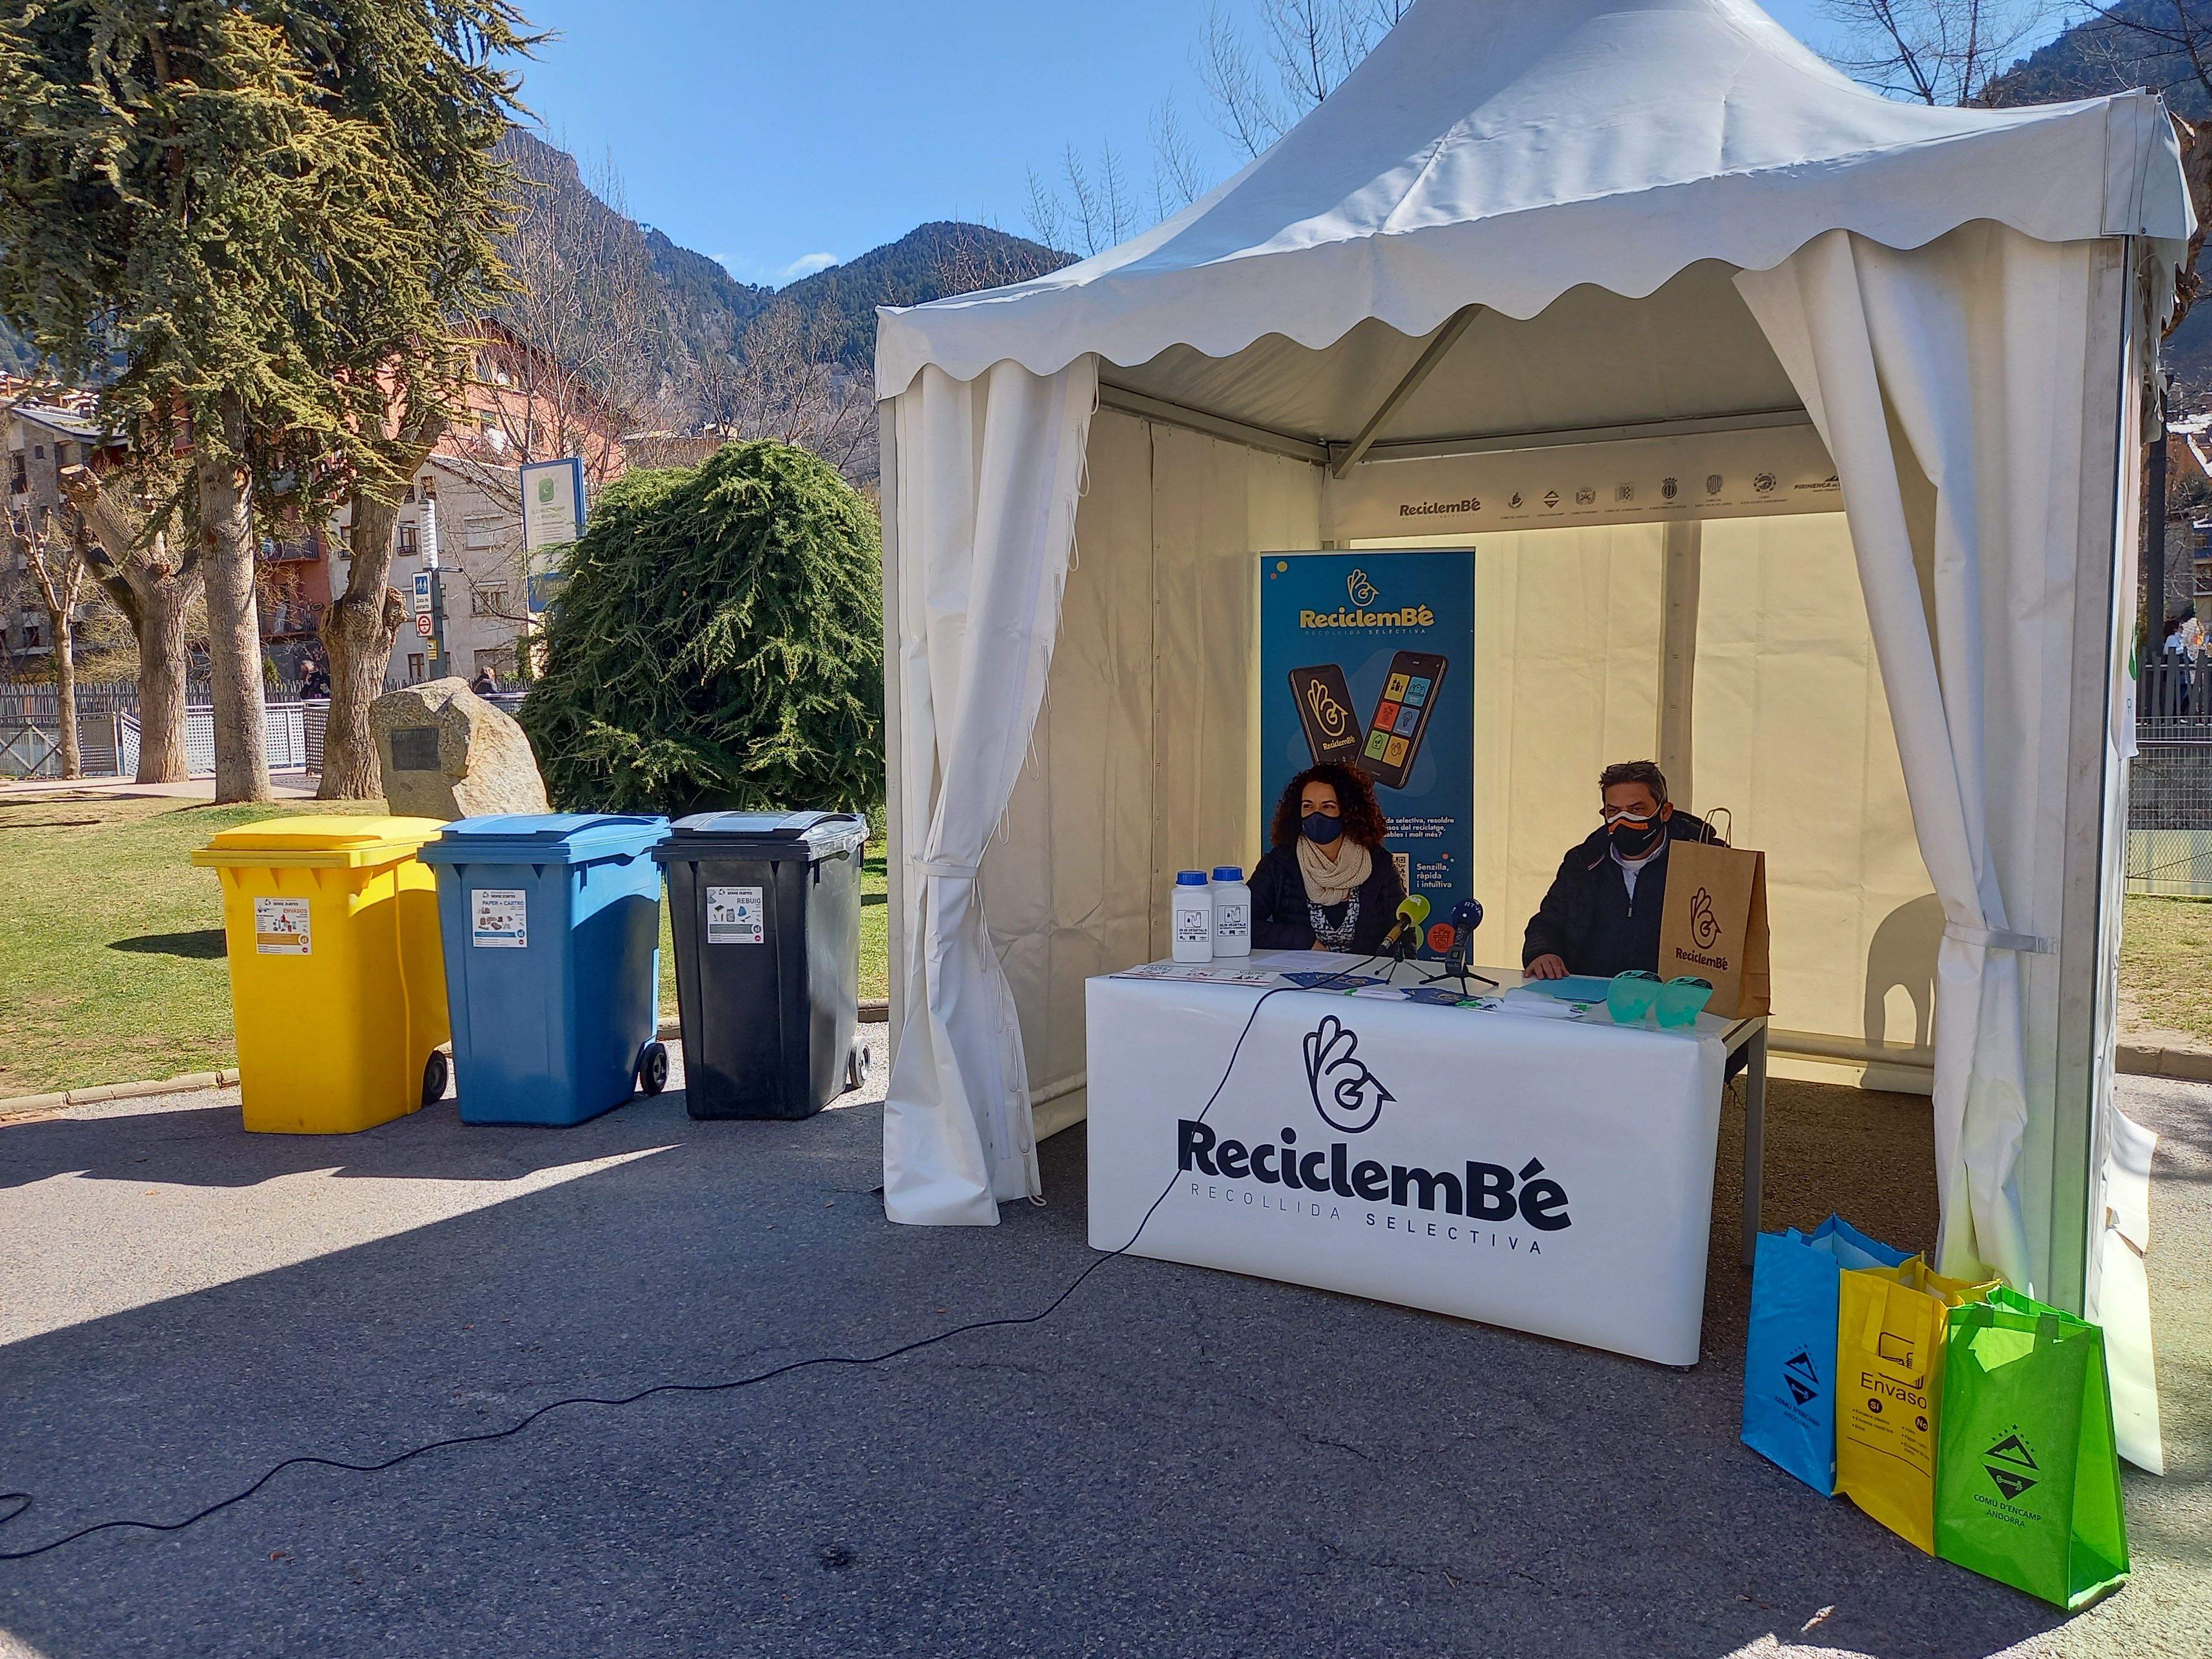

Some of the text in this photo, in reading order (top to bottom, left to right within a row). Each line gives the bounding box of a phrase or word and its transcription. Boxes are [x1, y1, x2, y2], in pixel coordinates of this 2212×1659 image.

[1400, 498, 1481, 516] ReciclemBé
[1300, 604, 1435, 628] ReciclemBé
[1322, 734, 1356, 752] ReciclemBé
[1412, 823, 1446, 832] reciclatge,
[1416, 863, 1449, 872] Senzilla,
[1416, 872, 1442, 881] ràpida
[1676, 947, 1728, 971] ReciclemBé
[1178, 1119, 1572, 1231] ReciclemBé
[1191, 1183, 1541, 1254] RECOLLIDA SELECTIVA
[1870, 1400, 1880, 1411] Sí
[1916, 1418, 1928, 1430] No
[1973, 1494, 2042, 1522] COMÚ D'ENCAMP
[1986, 1509, 2026, 1528] ANDORRA
